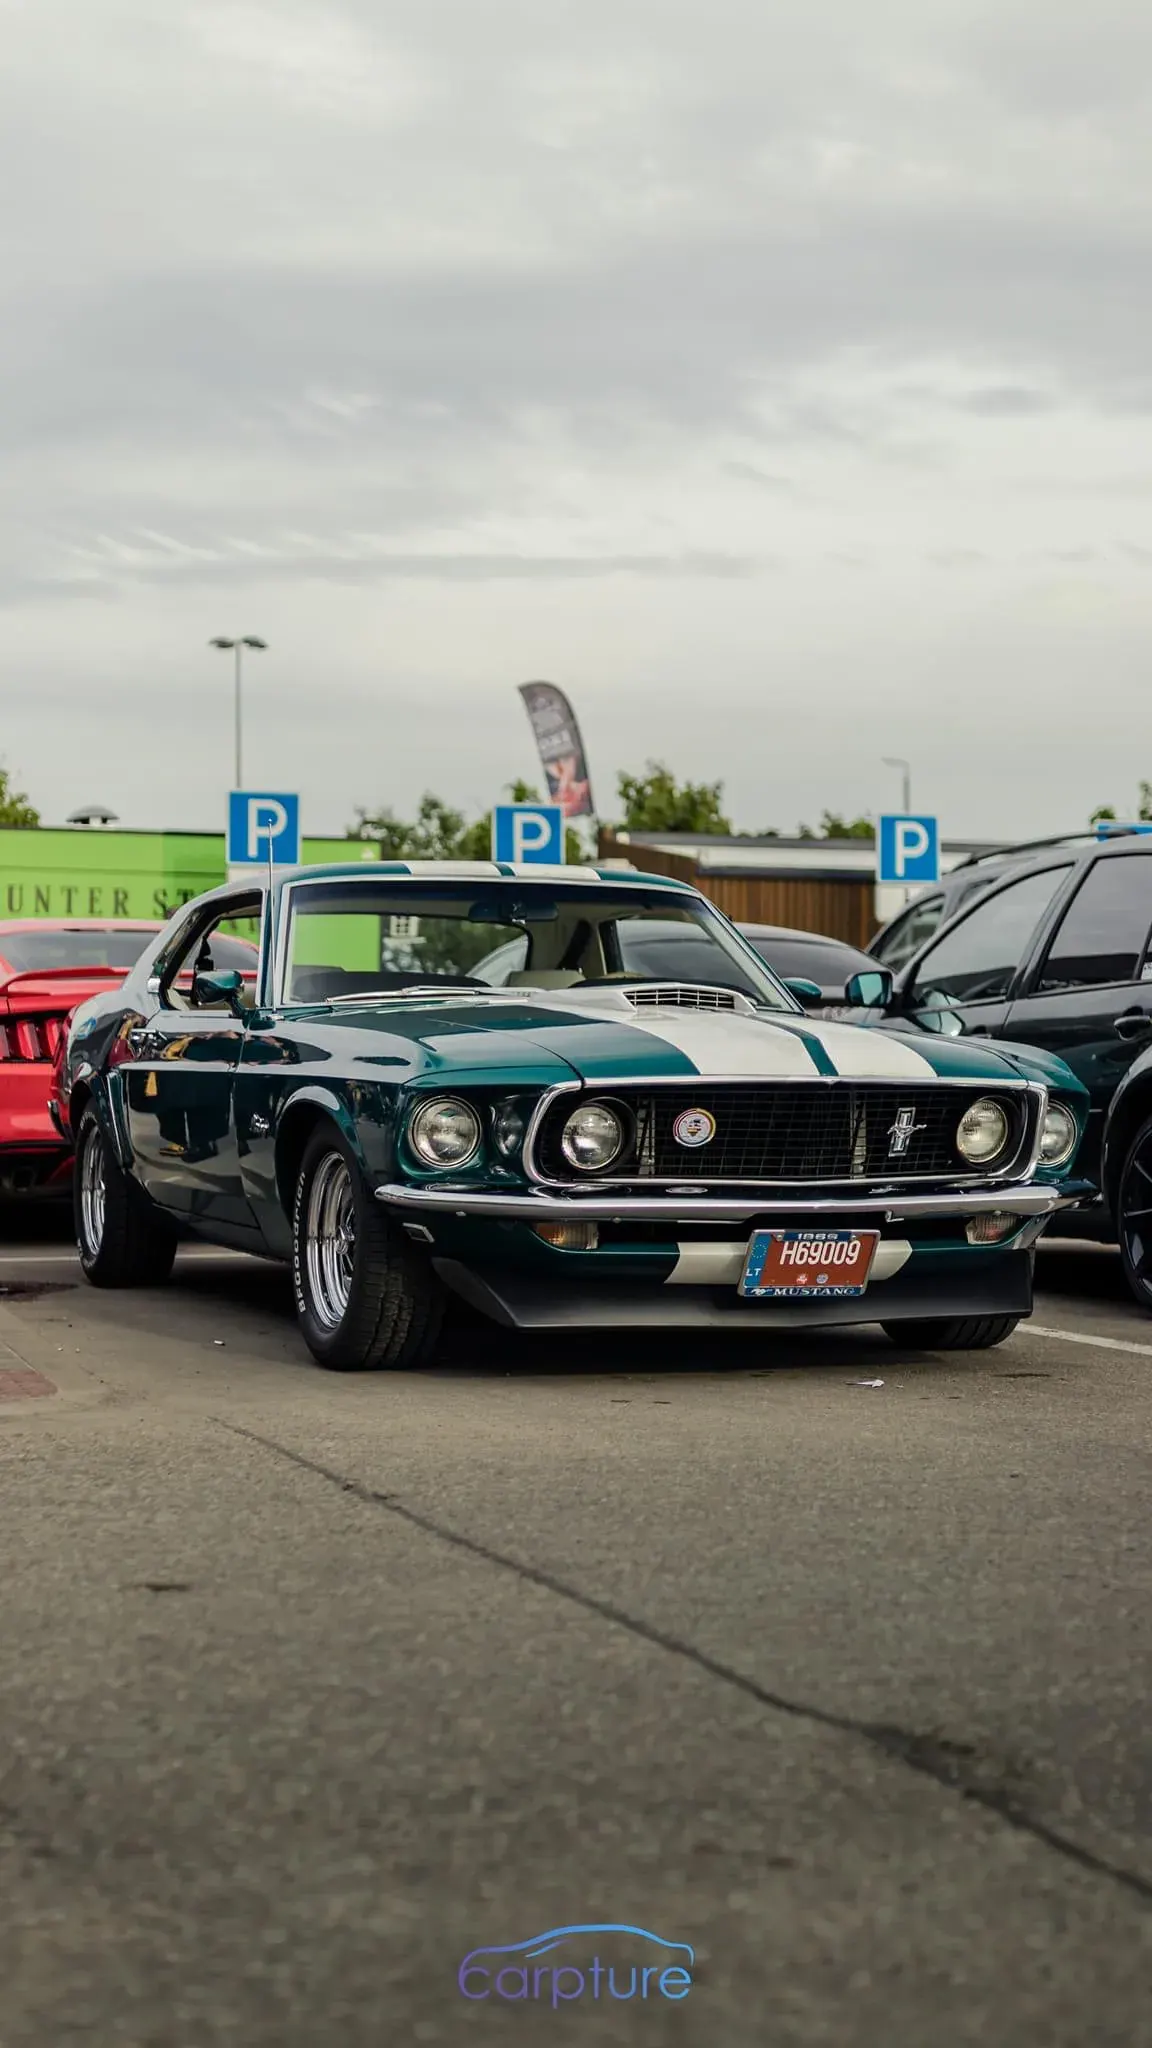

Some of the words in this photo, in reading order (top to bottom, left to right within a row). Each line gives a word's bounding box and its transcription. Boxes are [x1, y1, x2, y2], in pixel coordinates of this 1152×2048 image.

[247, 798, 288, 858] P
[512, 811, 552, 864] P
[894, 820, 930, 878] P
[780, 1240, 861, 1265] H69009
[746, 1268, 762, 1277] LT
[773, 1287, 856, 1297] MUSTANG
